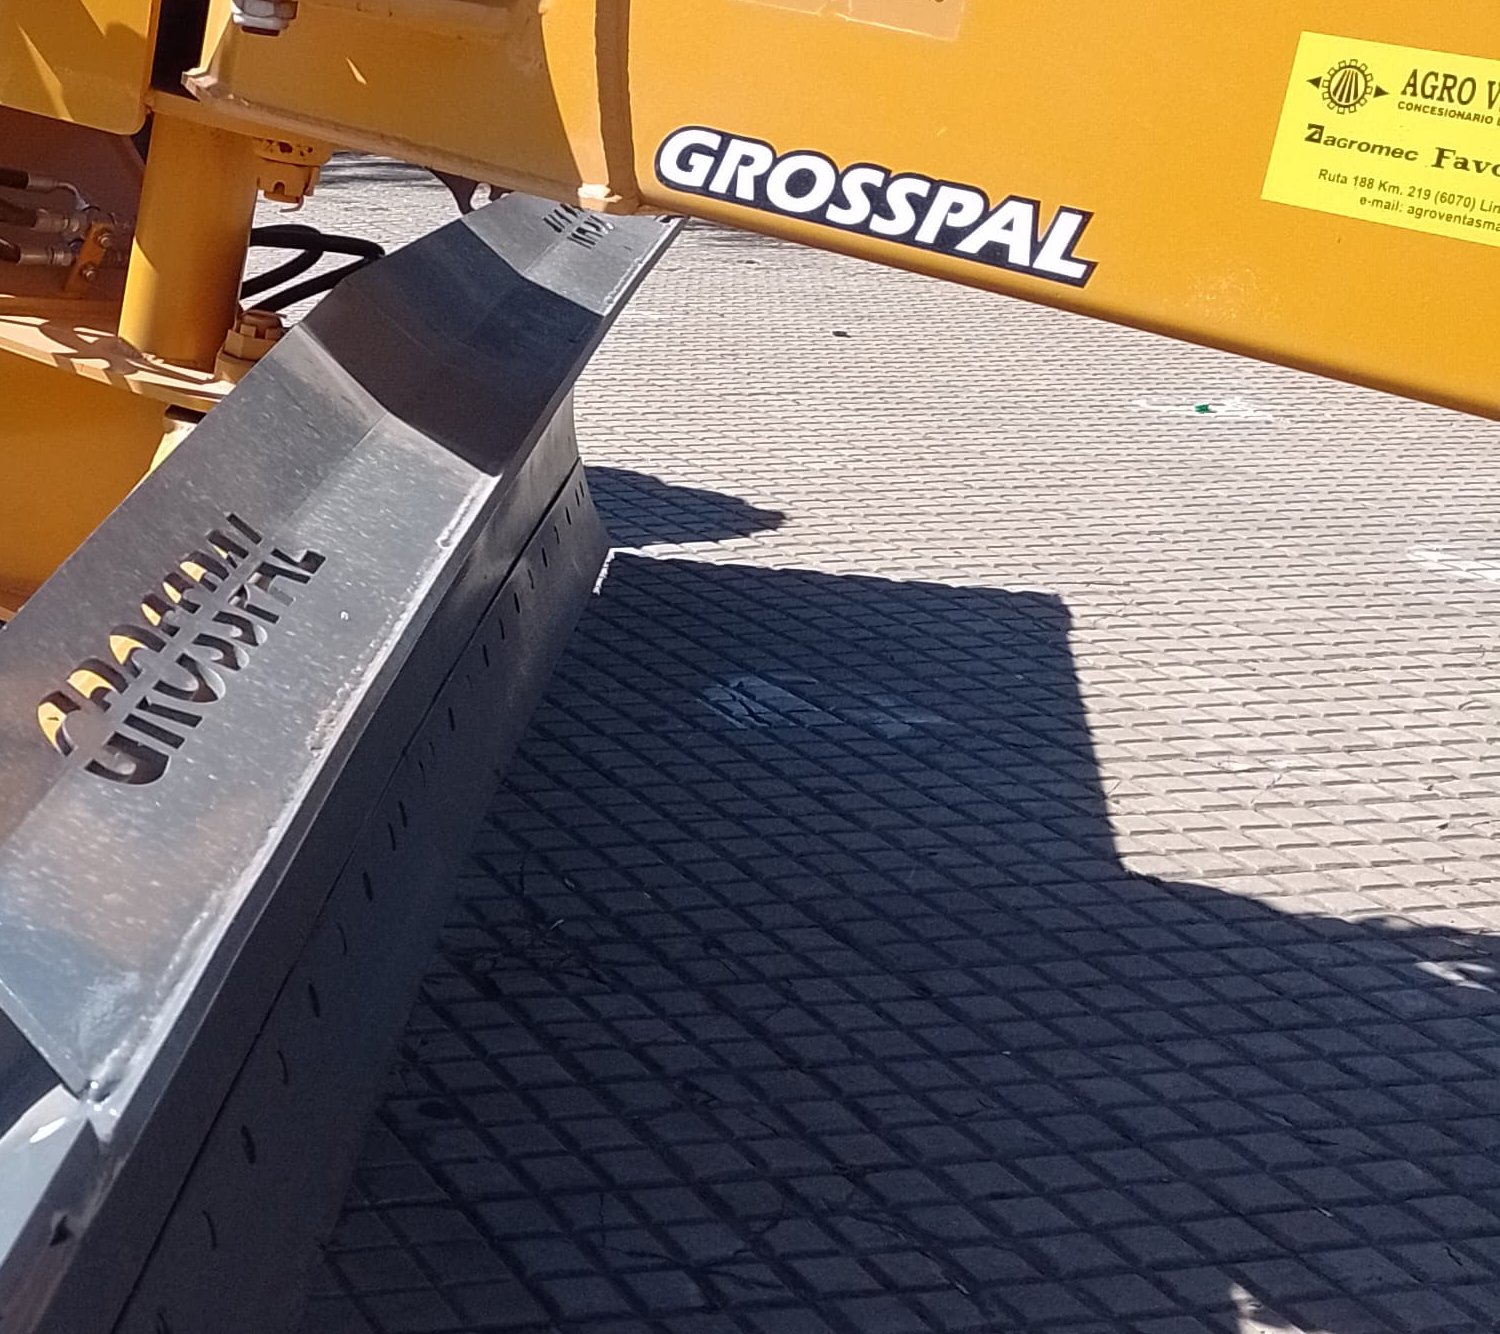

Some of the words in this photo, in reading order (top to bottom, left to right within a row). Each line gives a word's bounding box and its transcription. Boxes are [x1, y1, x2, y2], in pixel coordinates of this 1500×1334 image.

[1400, 68, 1477, 106] AGRO
[1397, 100, 1494, 125] CONCESIONARIO
[657, 127, 1093, 283] GROSSPAL
[1318, 168, 1348, 185] Ruta
[1353, 175, 1375, 190] 188
[1378, 179, 1403, 196] Km.
[1407, 185, 1432, 201] 219
[1434, 190, 1476, 212] (6070)
[1359, 196, 1403, 213] e-mail:
